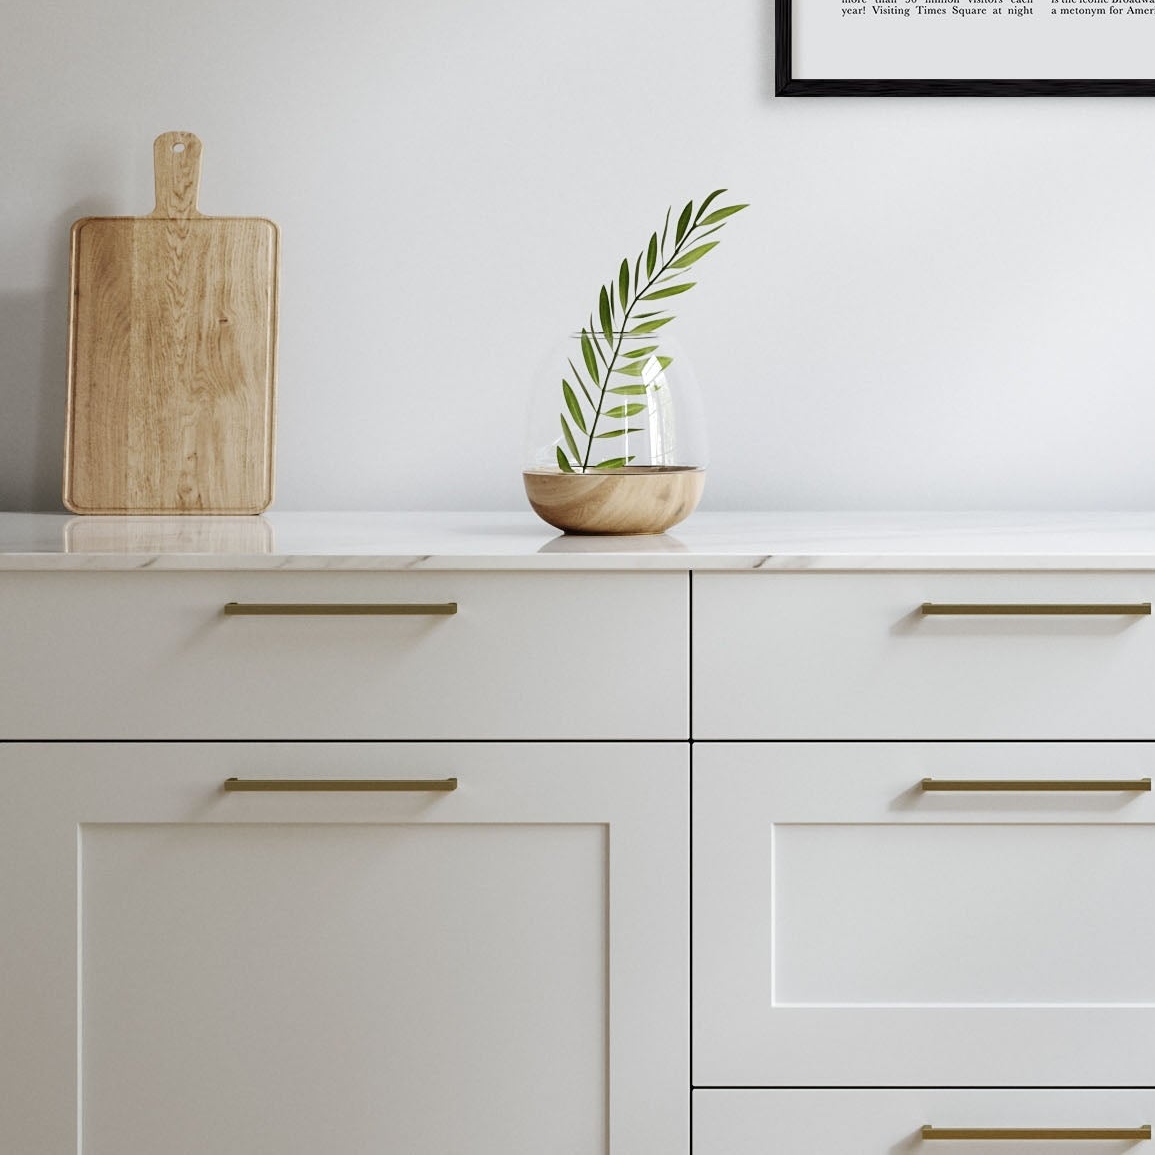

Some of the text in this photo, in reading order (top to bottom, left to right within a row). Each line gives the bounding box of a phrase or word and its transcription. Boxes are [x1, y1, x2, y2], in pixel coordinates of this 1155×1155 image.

[841, 6, 1033, 17] year! Visiting Times Square at night
[1060, 6, 1106, 17] metonym
[1109, 6, 1124, 15] for
